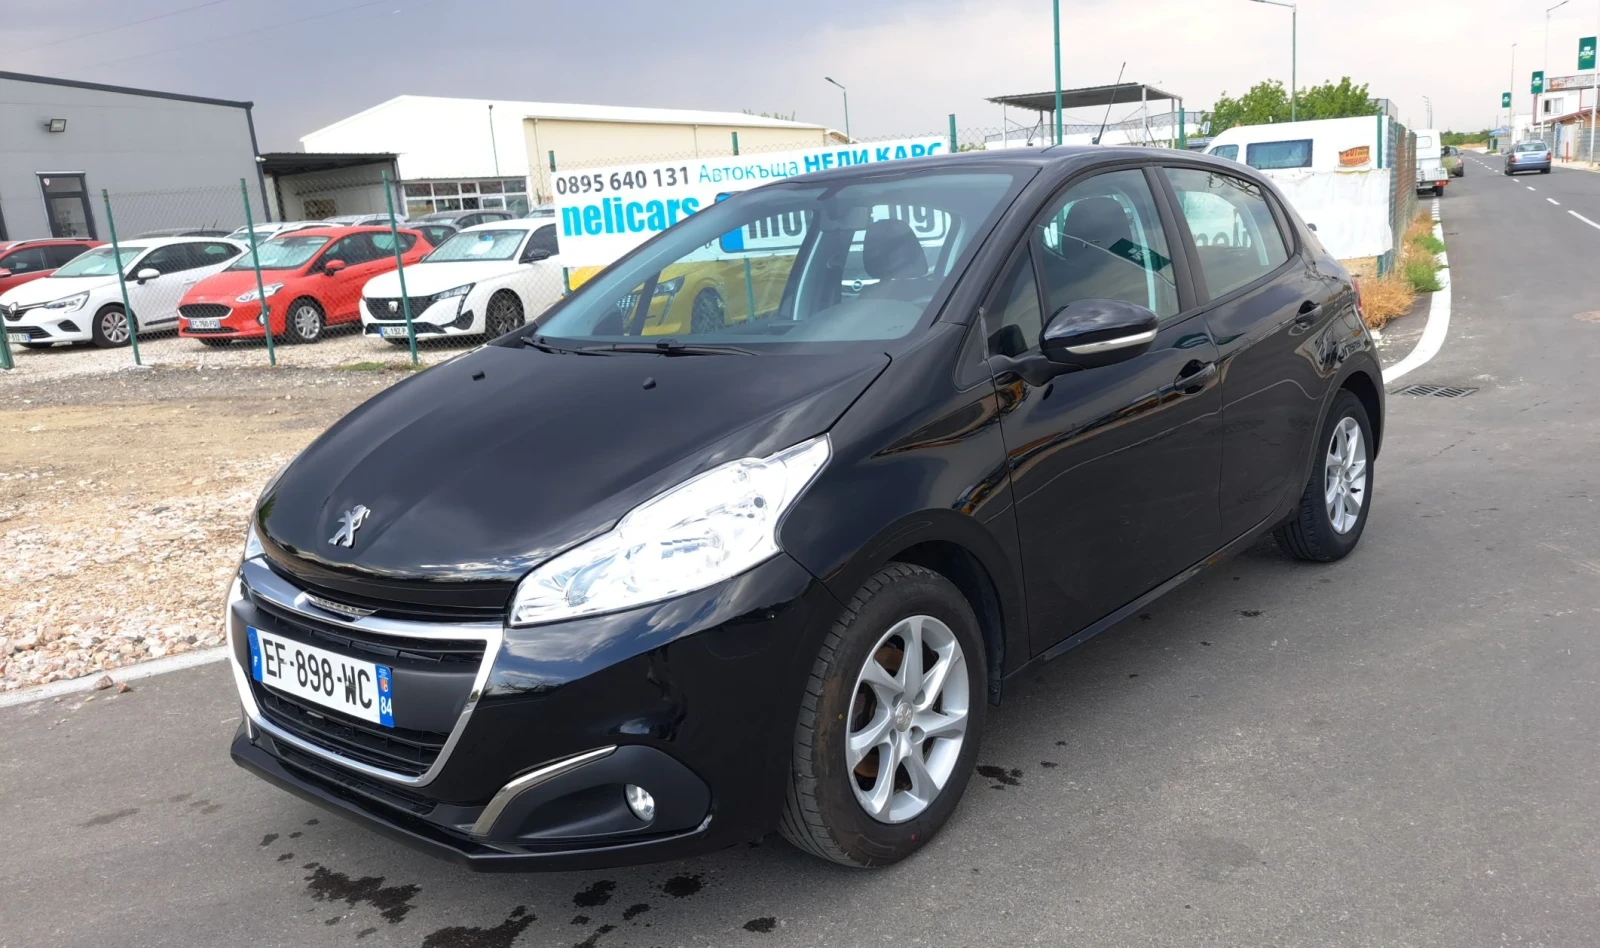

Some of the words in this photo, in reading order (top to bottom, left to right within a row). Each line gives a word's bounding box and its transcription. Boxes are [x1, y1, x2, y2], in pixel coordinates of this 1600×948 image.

[556, 174, 604, 195] 0895
[609, 170, 647, 191] 640
[653, 166, 689, 187] 131
[699, 161, 799, 183] Автокъща
[804, 149, 868, 173] НЕЛИ
[562, 197, 700, 236] nelicars
[262, 638, 373, 709] EF-898-WC
[380, 696, 392, 717] 84
